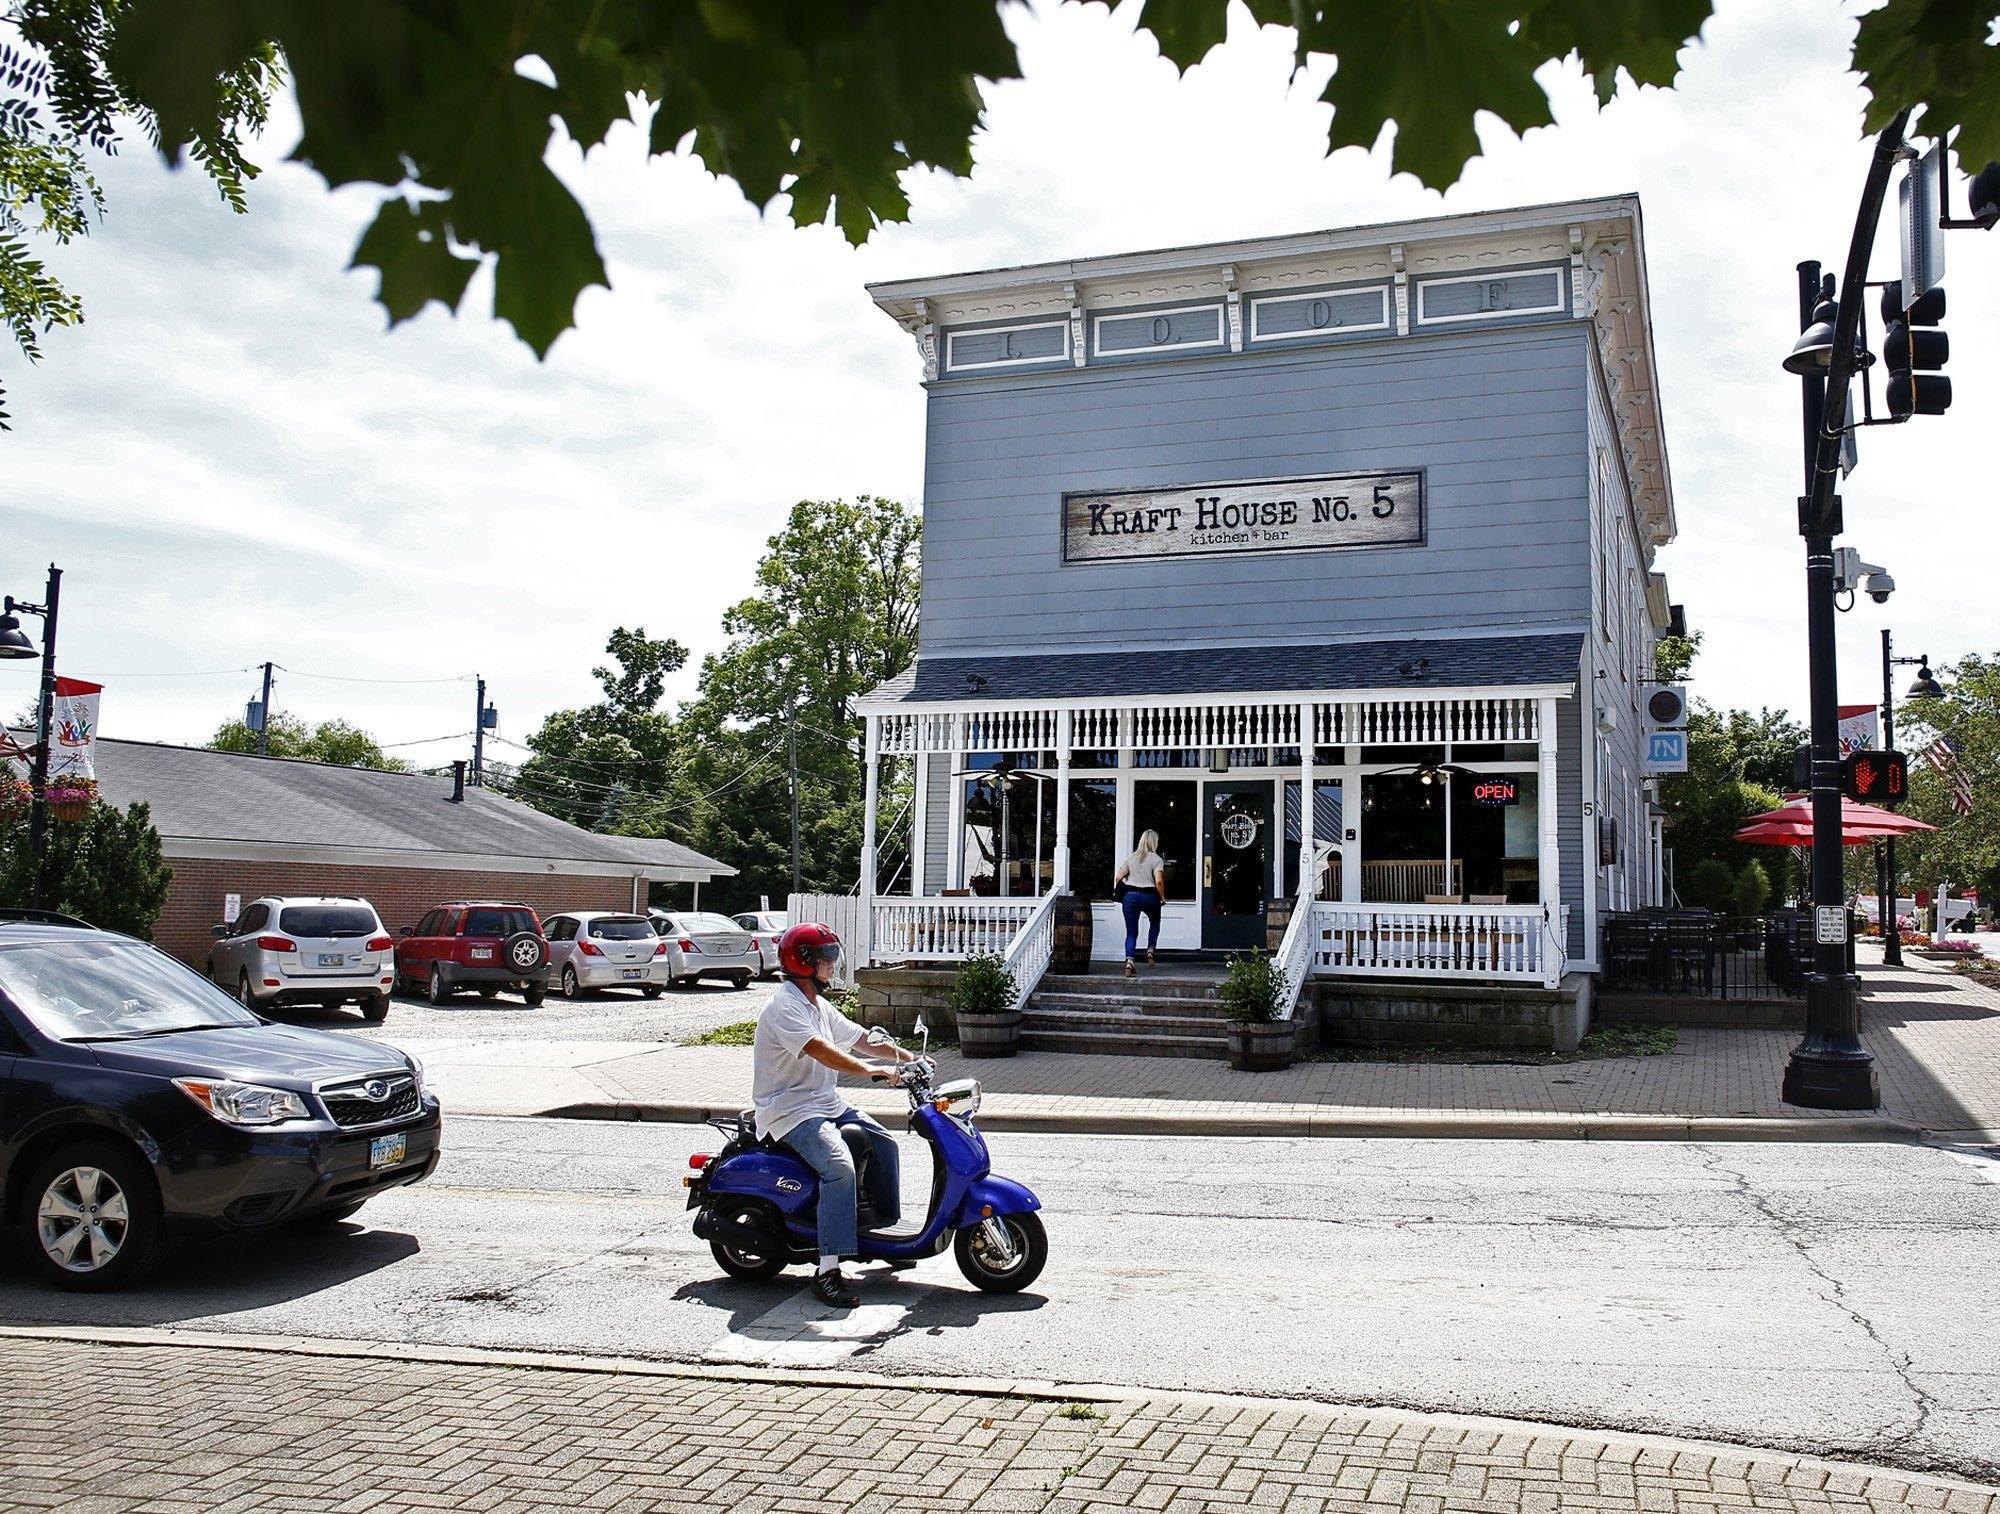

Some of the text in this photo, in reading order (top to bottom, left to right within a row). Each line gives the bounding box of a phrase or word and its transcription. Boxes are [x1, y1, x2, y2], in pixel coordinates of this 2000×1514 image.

[1087, 503, 1182, 536] KRAFT
[1194, 496, 1298, 530] HOUSE
[1372, 485, 1395, 519] 5
[1190, 532, 1249, 545] kitchen
[1263, 530, 1290, 541] bar
[1474, 785, 1514, 799] OPEN
[1583, 802, 1593, 817] 5
[1302, 853, 1309, 864] 5
